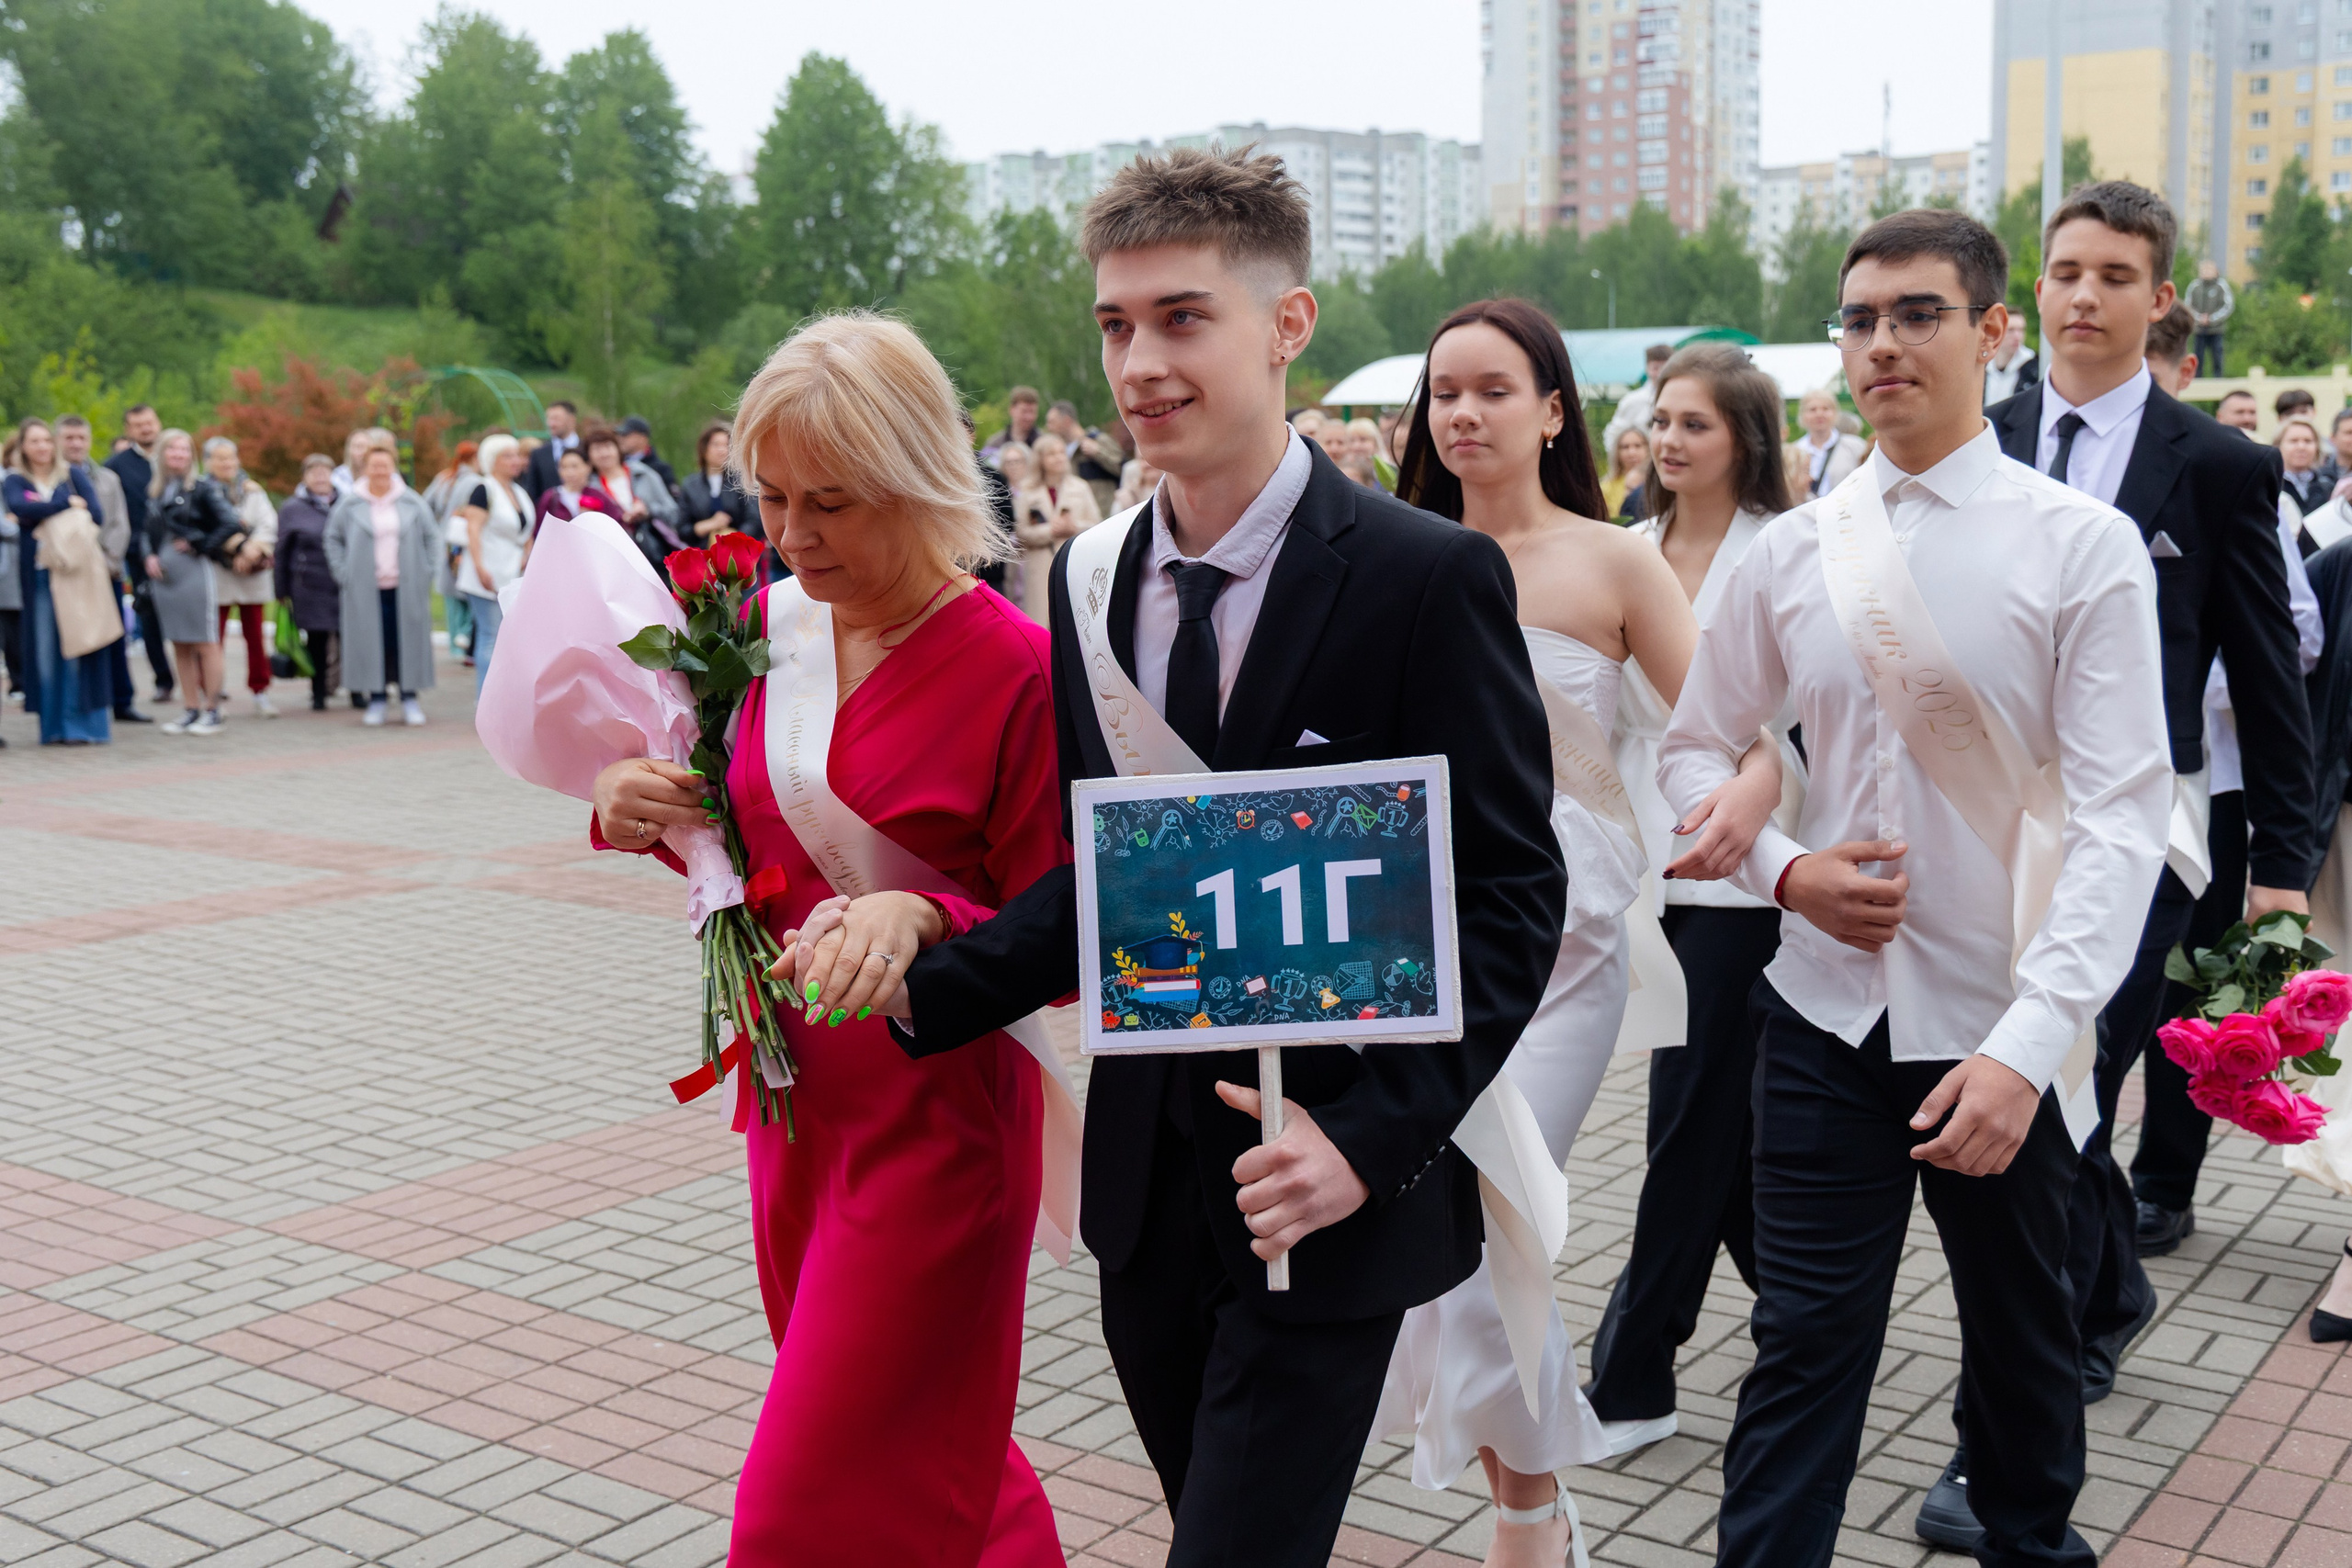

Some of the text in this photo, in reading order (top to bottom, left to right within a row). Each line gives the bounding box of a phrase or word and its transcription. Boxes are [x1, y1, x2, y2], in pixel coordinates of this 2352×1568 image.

[786, 673, 826, 797] Классный
[1897, 668, 1990, 751] 2025
[1196, 859, 1382, 950] 11Г
[1236, 975, 1250, 987] DNA
[1274, 1012, 1290, 1021] DNA
